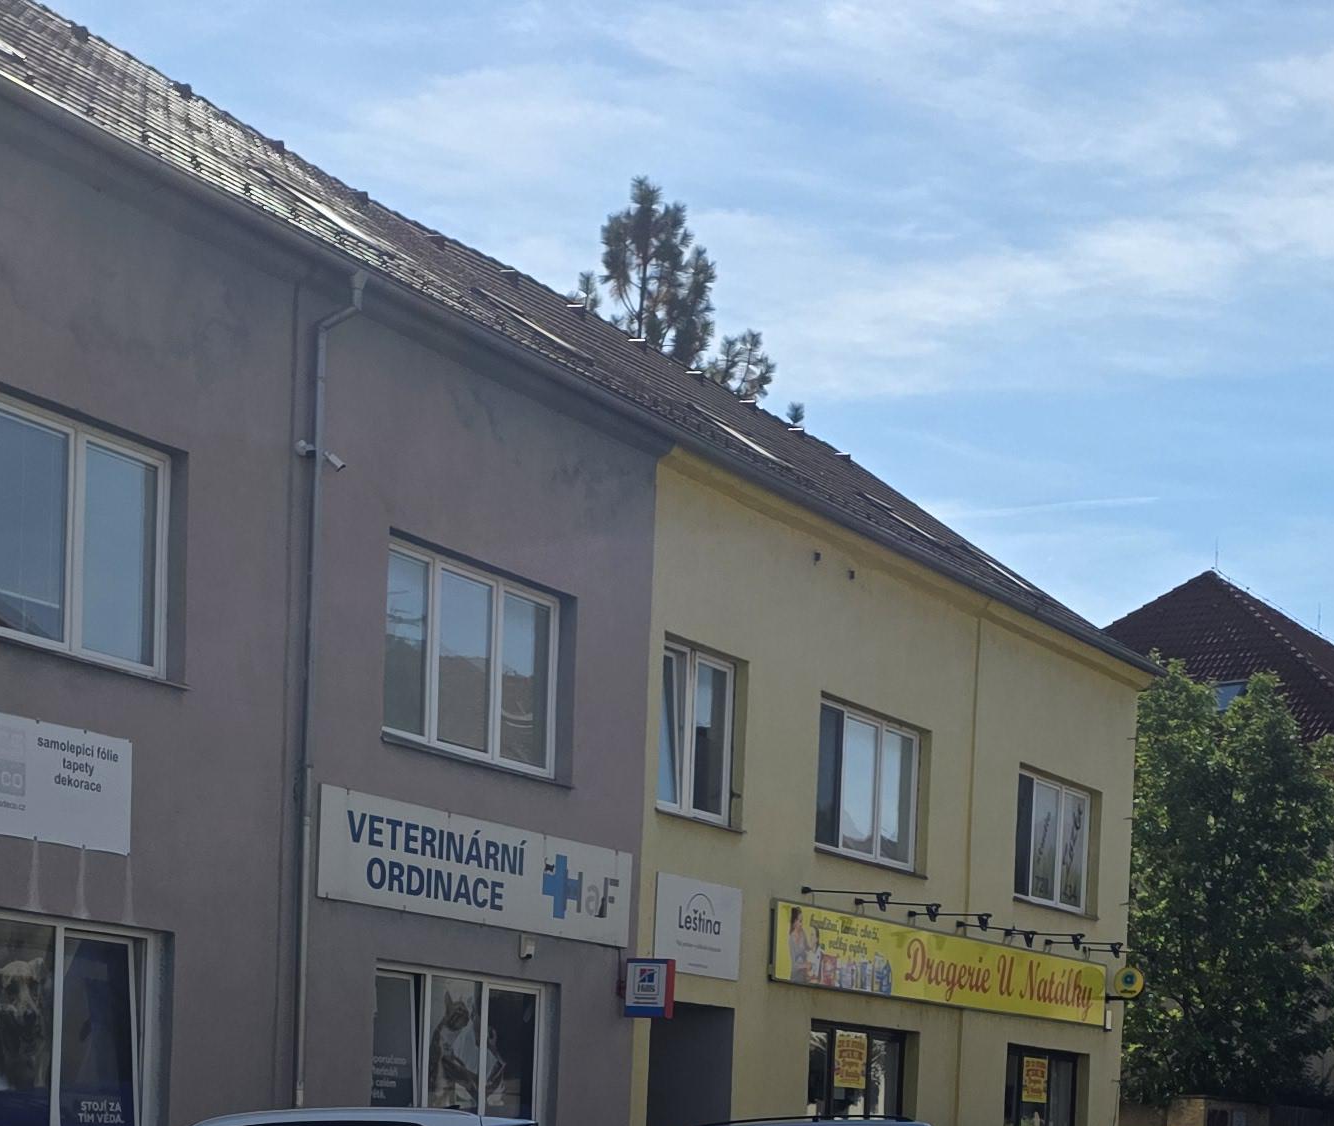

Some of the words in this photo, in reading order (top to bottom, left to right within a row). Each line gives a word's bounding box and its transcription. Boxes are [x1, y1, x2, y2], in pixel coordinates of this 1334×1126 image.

[97, 747, 119, 762] fólie
[63, 758, 94, 777] tapety
[54, 773, 102, 793] dekorace
[347, 810, 528, 876] VETERINÁRNÍ
[367, 857, 504, 911] ORDINACE
[678, 905, 721, 935] Leština
[904, 938, 991, 1001] Drogerie
[997, 954, 1014, 997] U
[1019, 959, 1095, 1020] Natálky
[80, 1099, 107, 1111] STOJÍ
[109, 1102, 122, 1112] ZA
[77, 1110, 95, 1123] TÍM
